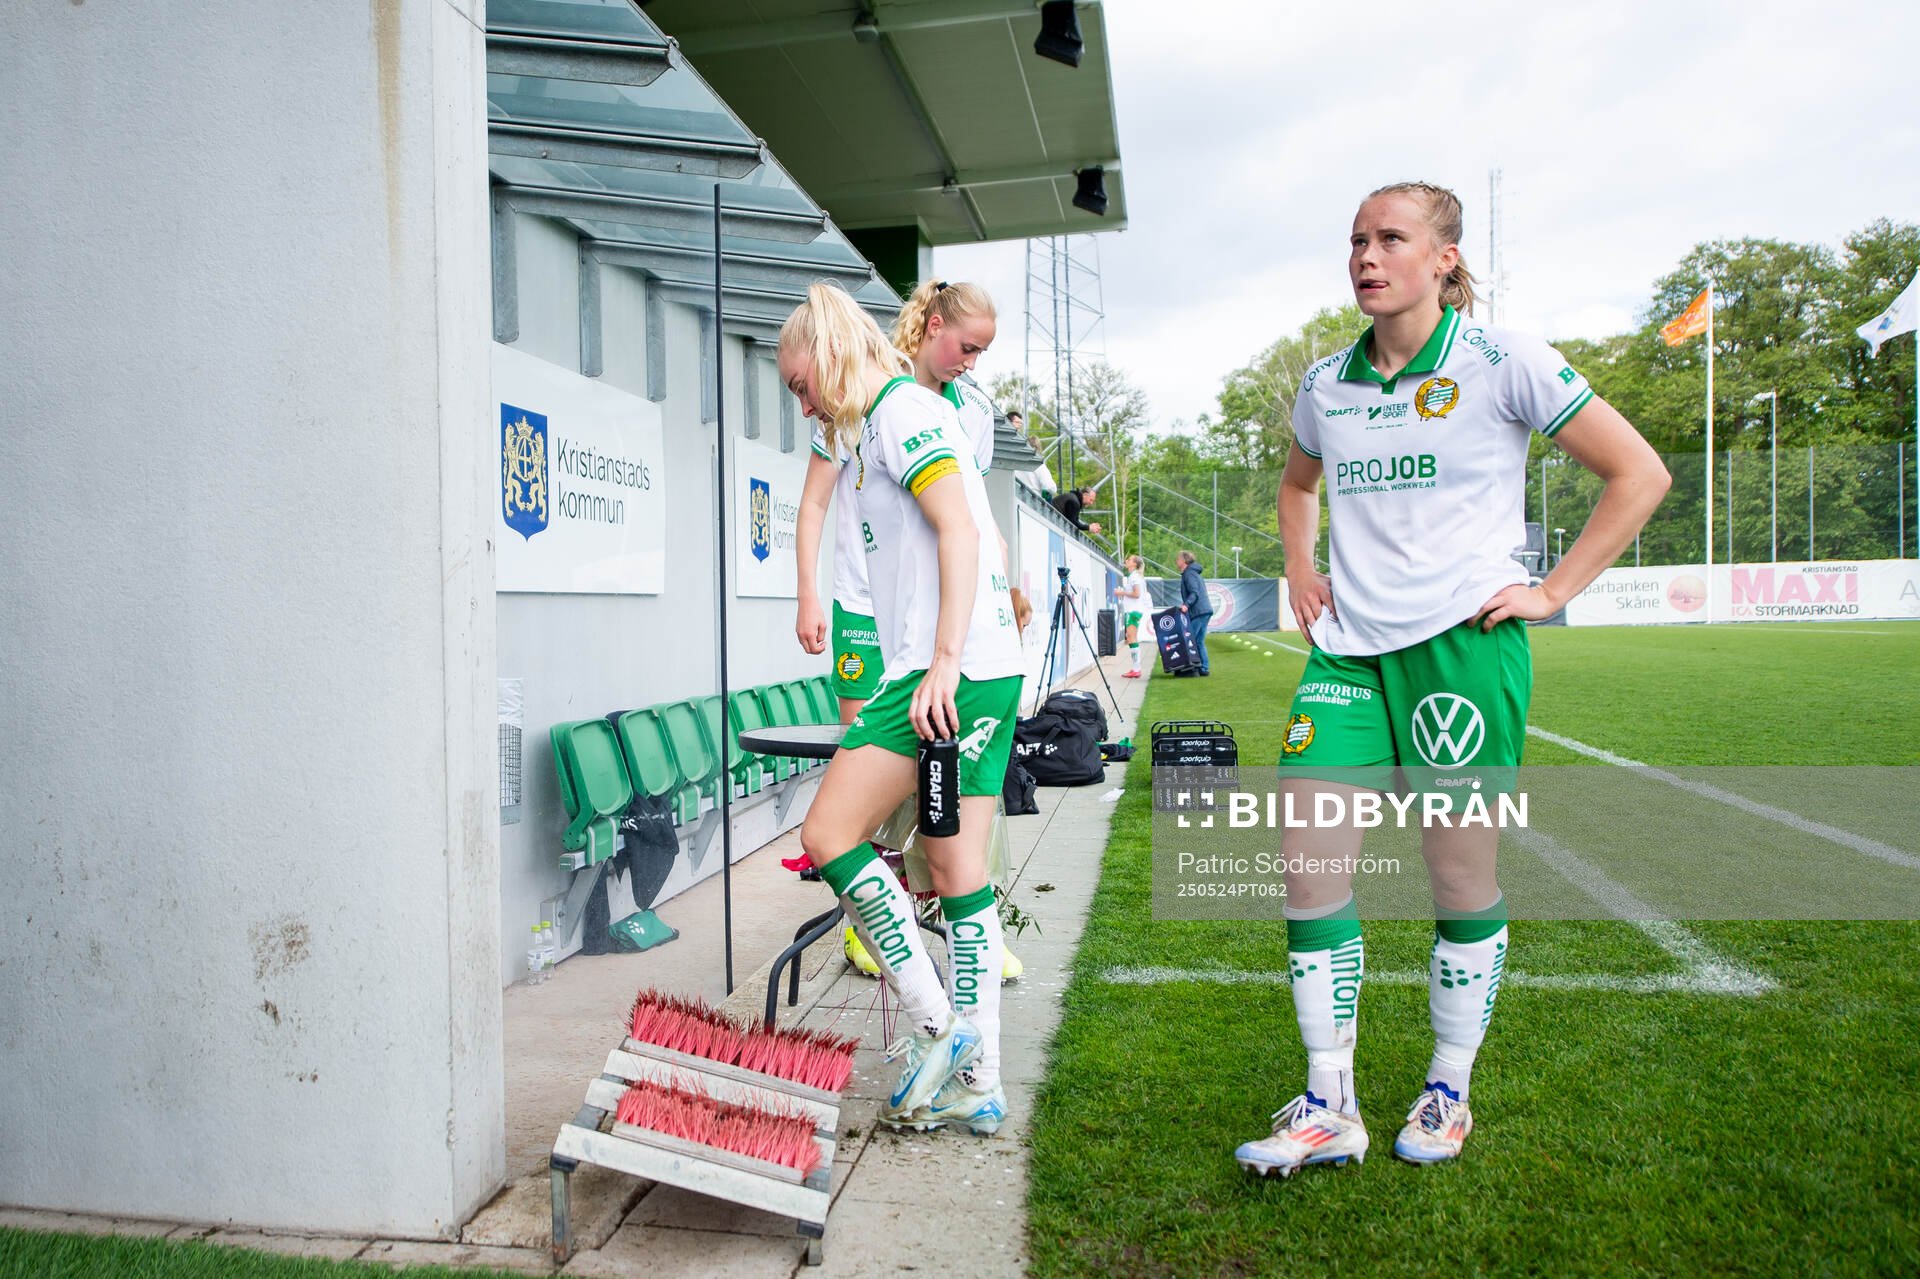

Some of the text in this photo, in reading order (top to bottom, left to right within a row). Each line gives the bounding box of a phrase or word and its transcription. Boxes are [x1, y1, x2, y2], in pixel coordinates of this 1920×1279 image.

[1462, 328, 1509, 366] Convini
[1325, 407, 1354, 418] CRAFT
[1382, 402, 1408, 411] INTER
[1382, 410, 1407, 419] SPORT
[902, 427, 943, 454] BST
[557, 437, 650, 491] Kristianstads
[1337, 454, 1437, 486] PROJOB
[1337, 480, 1436, 497] PROFESSIONAL WORKWEAR
[558, 482, 624, 525] kommun
[1802, 565, 1858, 574] KRISTIANSTAD
[1583, 579, 1659, 596] parbanken
[1731, 568, 1858, 604] MAXI
[1615, 595, 1660, 610] Skåne
[1755, 604, 1859, 617] STORMARKNAD
[929, 760, 942, 811] CRAFT
[1435, 777, 1473, 787] CRAFT
[849, 875, 913, 967] Clinton
[952, 920, 988, 1006] Clinton
[1330, 940, 1363, 1020] linton
